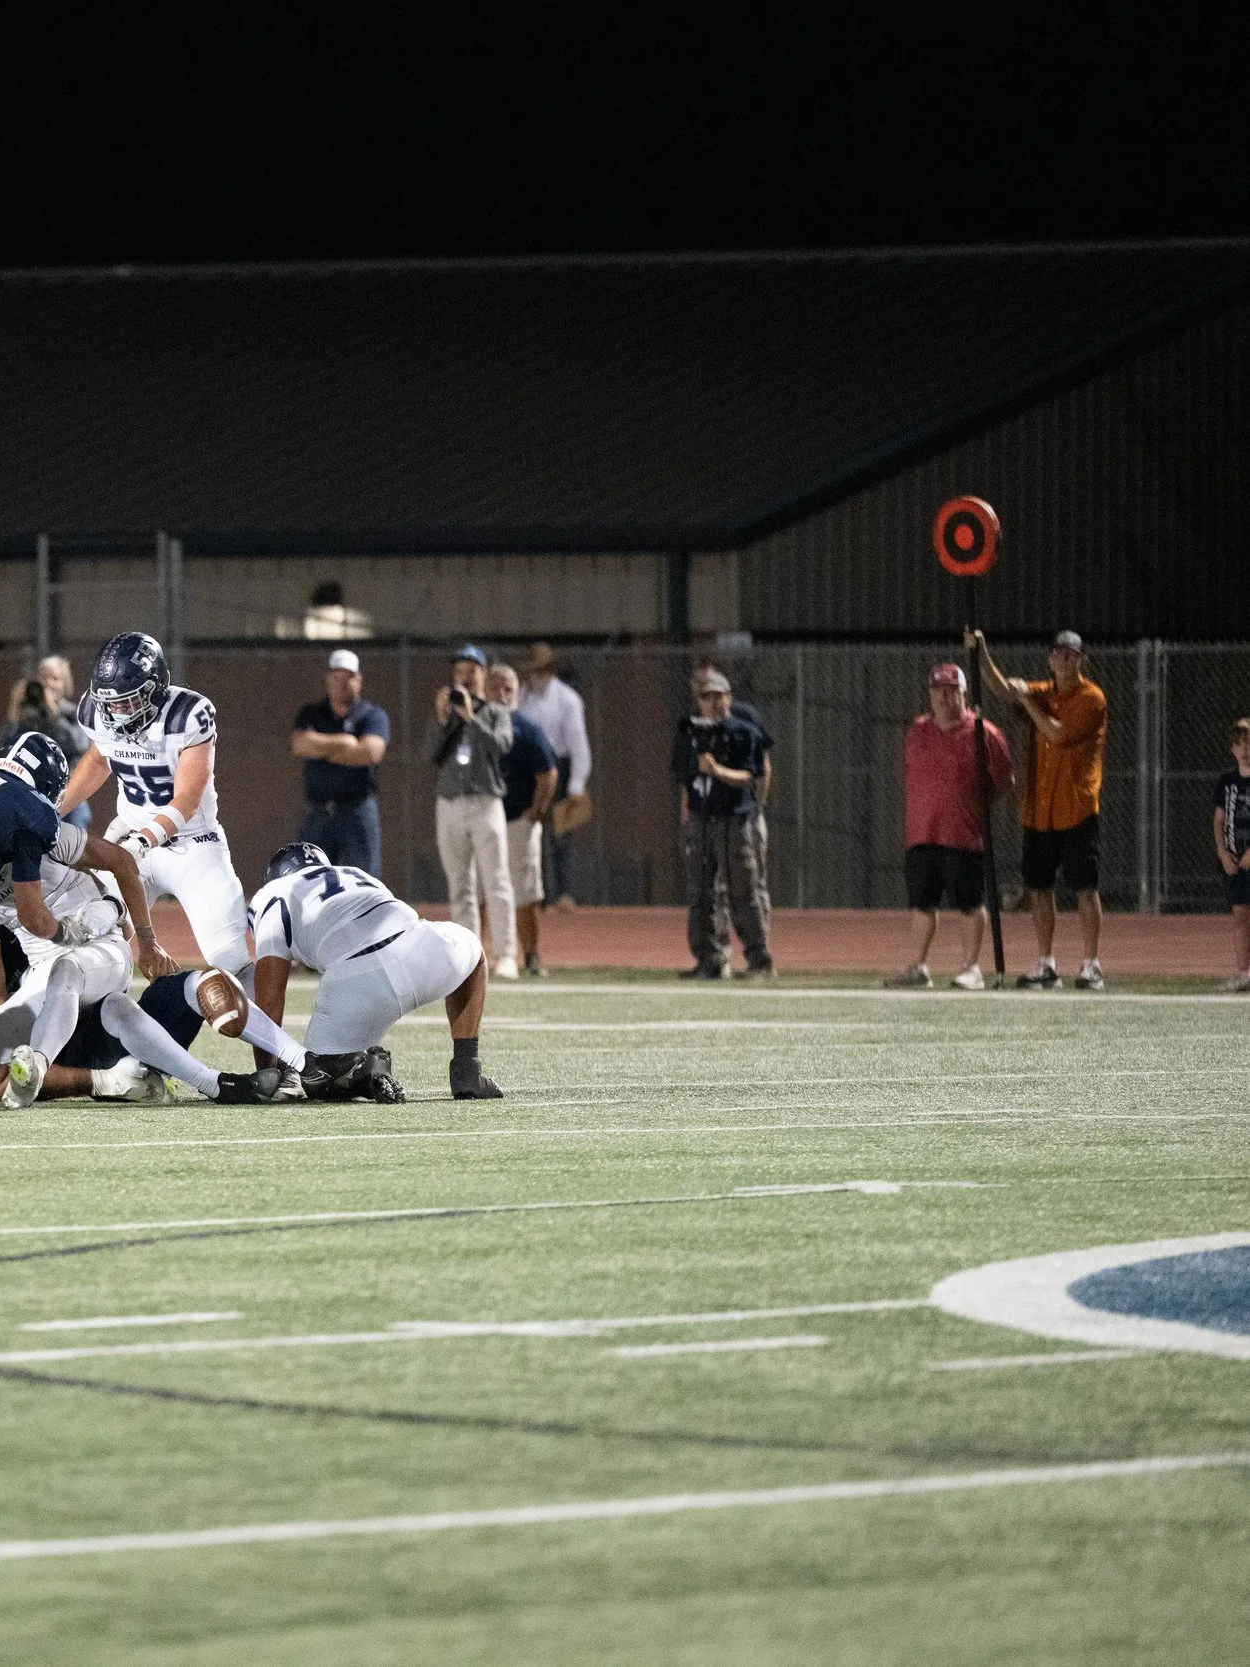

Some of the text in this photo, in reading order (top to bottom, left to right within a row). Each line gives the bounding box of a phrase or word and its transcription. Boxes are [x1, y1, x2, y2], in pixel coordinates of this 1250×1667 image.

[194, 704, 215, 734] 55
[114, 749, 156, 760] CHAMPION
[109, 759, 175, 807] 55
